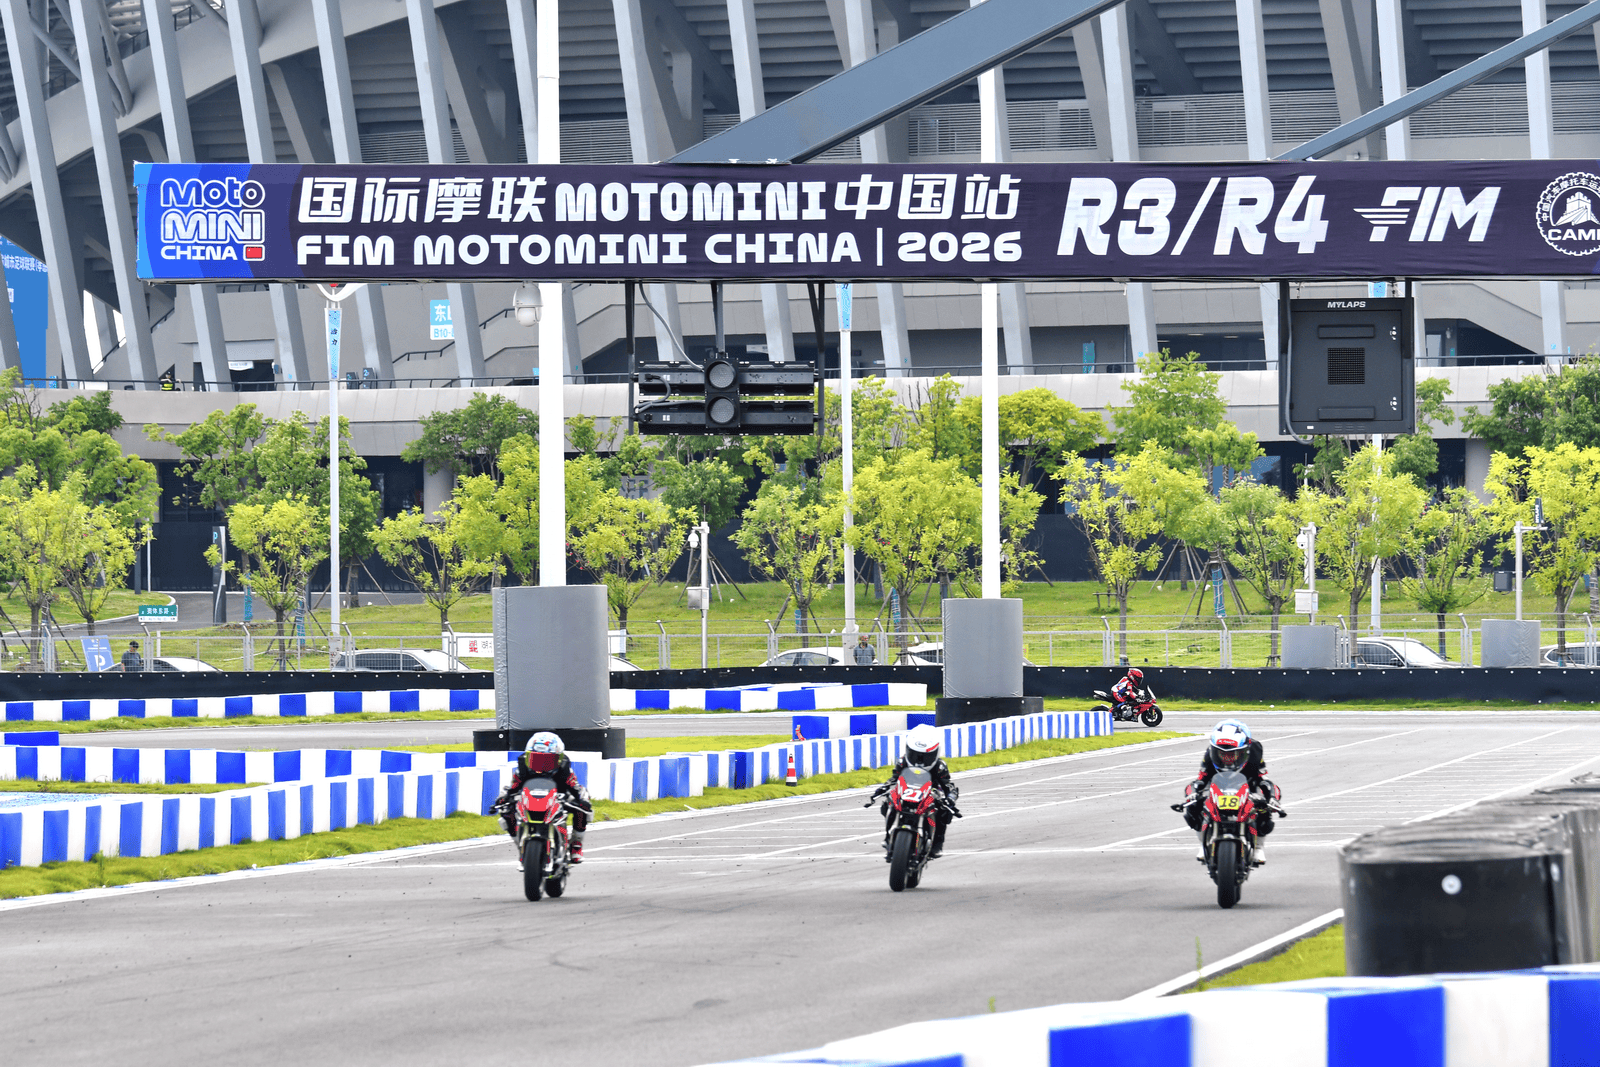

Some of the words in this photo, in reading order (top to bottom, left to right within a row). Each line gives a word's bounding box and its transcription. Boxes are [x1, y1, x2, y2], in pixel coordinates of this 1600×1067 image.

[160, 177, 266, 208] Moto
[297, 177, 548, 223] 国际摩联
[555, 182, 827, 221] MOTOMINI
[834, 173, 1022, 220] 中国站
[160, 208, 266, 244] MINI
[1056, 175, 1329, 256] R3/R4
[1354, 186, 1502, 242] FIM
[160, 245, 238, 261] CHINA
[297, 234, 395, 266] FIM
[413, 232, 687, 266] MOTOMINI
[704, 231, 862, 264] CHINA
[897, 230, 1023, 262] 2026
[434, 304, 452, 322] 东
[902, 789, 923, 802] 21
[1219, 797, 1239, 808] 18
